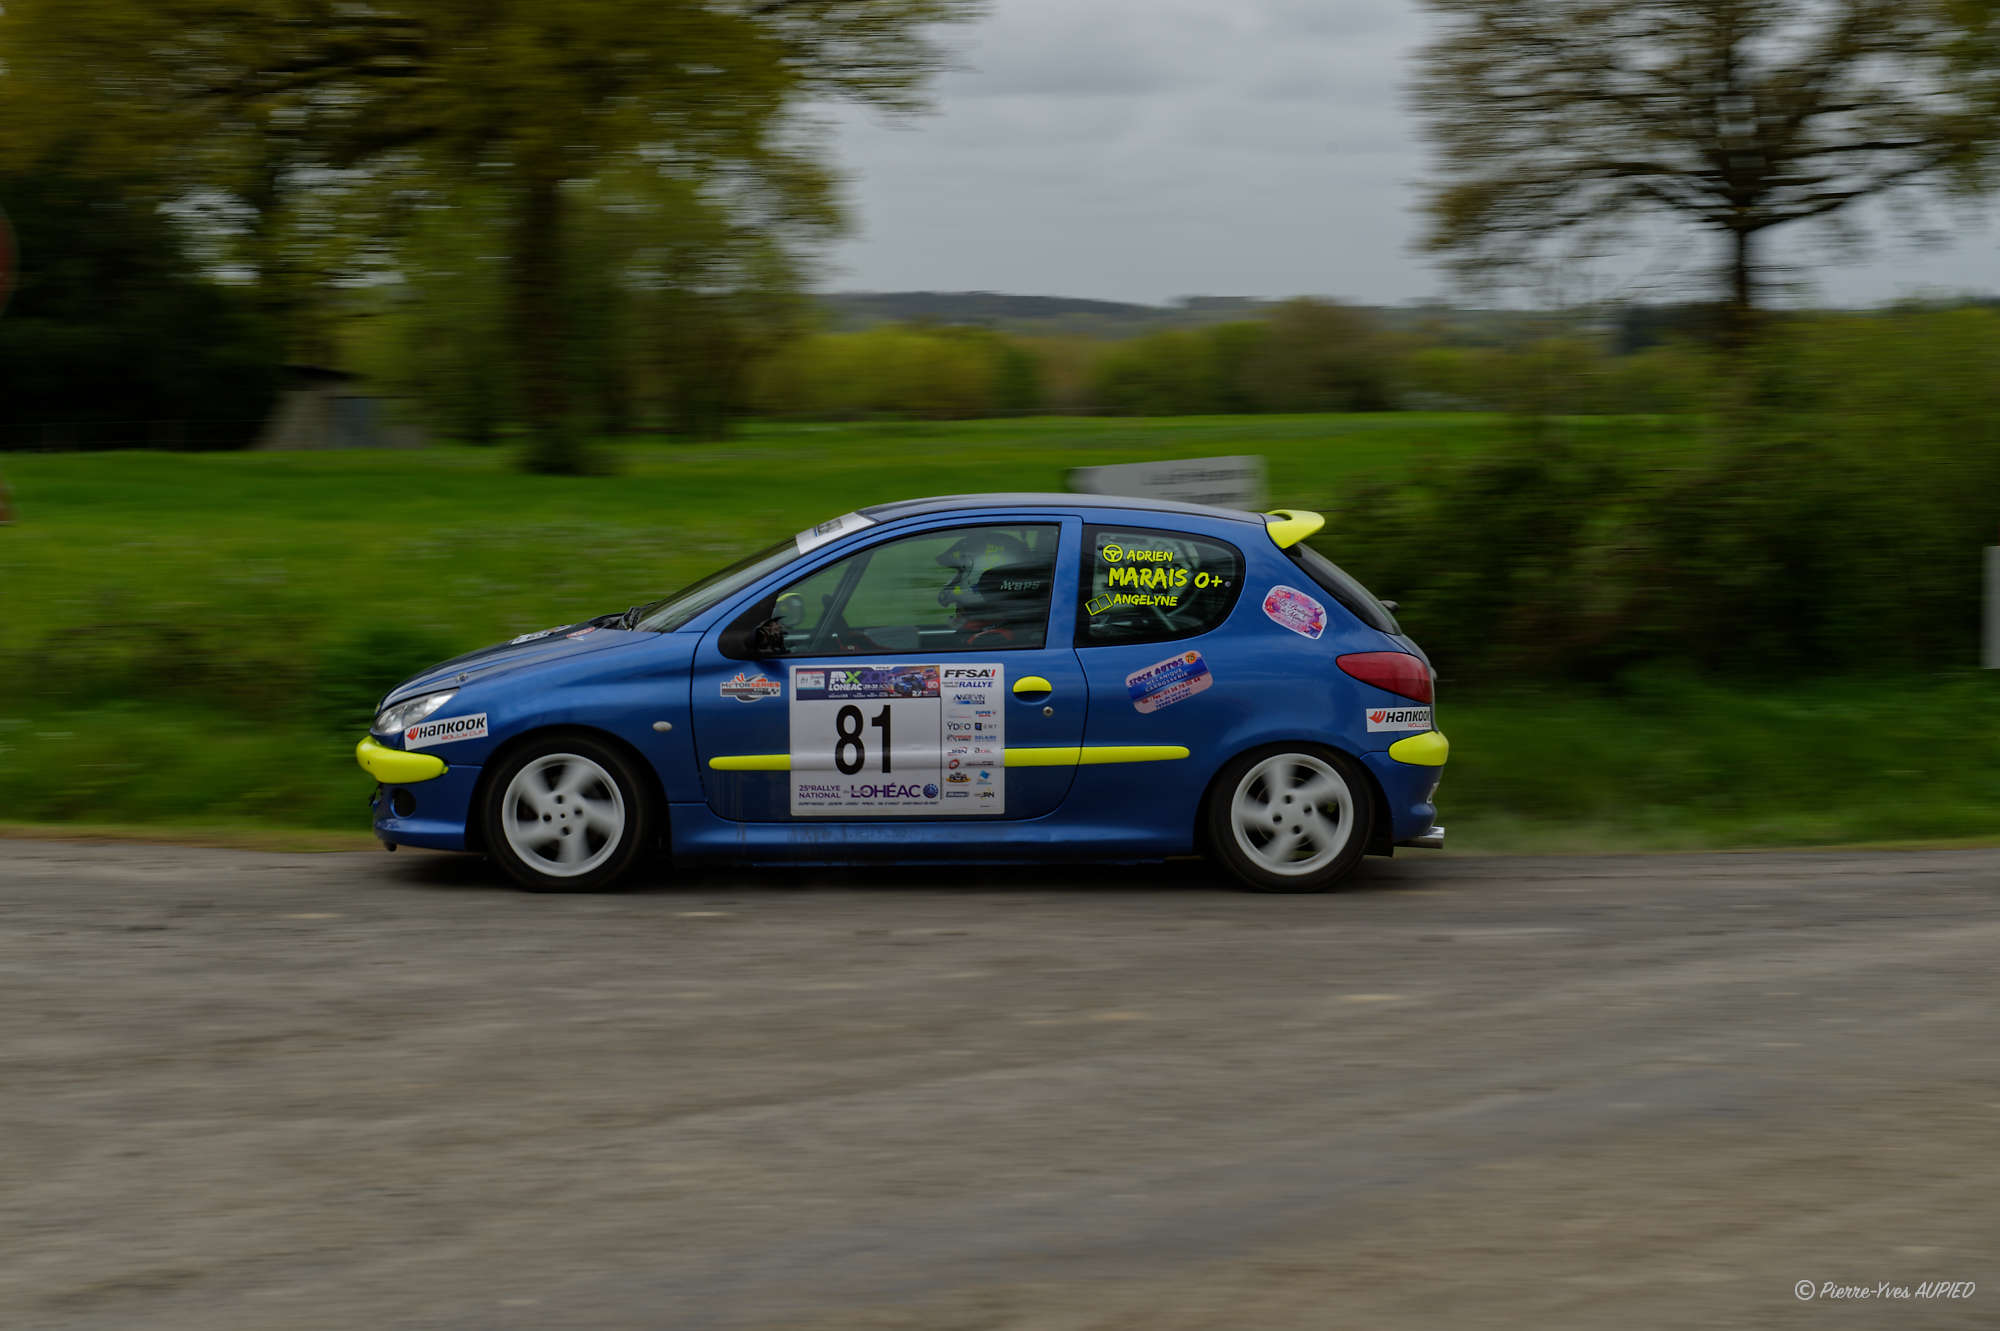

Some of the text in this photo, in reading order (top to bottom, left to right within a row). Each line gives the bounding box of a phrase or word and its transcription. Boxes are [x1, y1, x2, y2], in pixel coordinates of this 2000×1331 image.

[1127, 549, 1174, 562] ADRIEN
[1108, 566, 1188, 589] MARAIS
[1113, 592, 1178, 607] ANGELYNE
[944, 669, 990, 678] FFSA
[1128, 657, 1184, 686] STOCK AUTOS
[835, 704, 892, 775] 81
[851, 782, 921, 798] LOHÉAC
